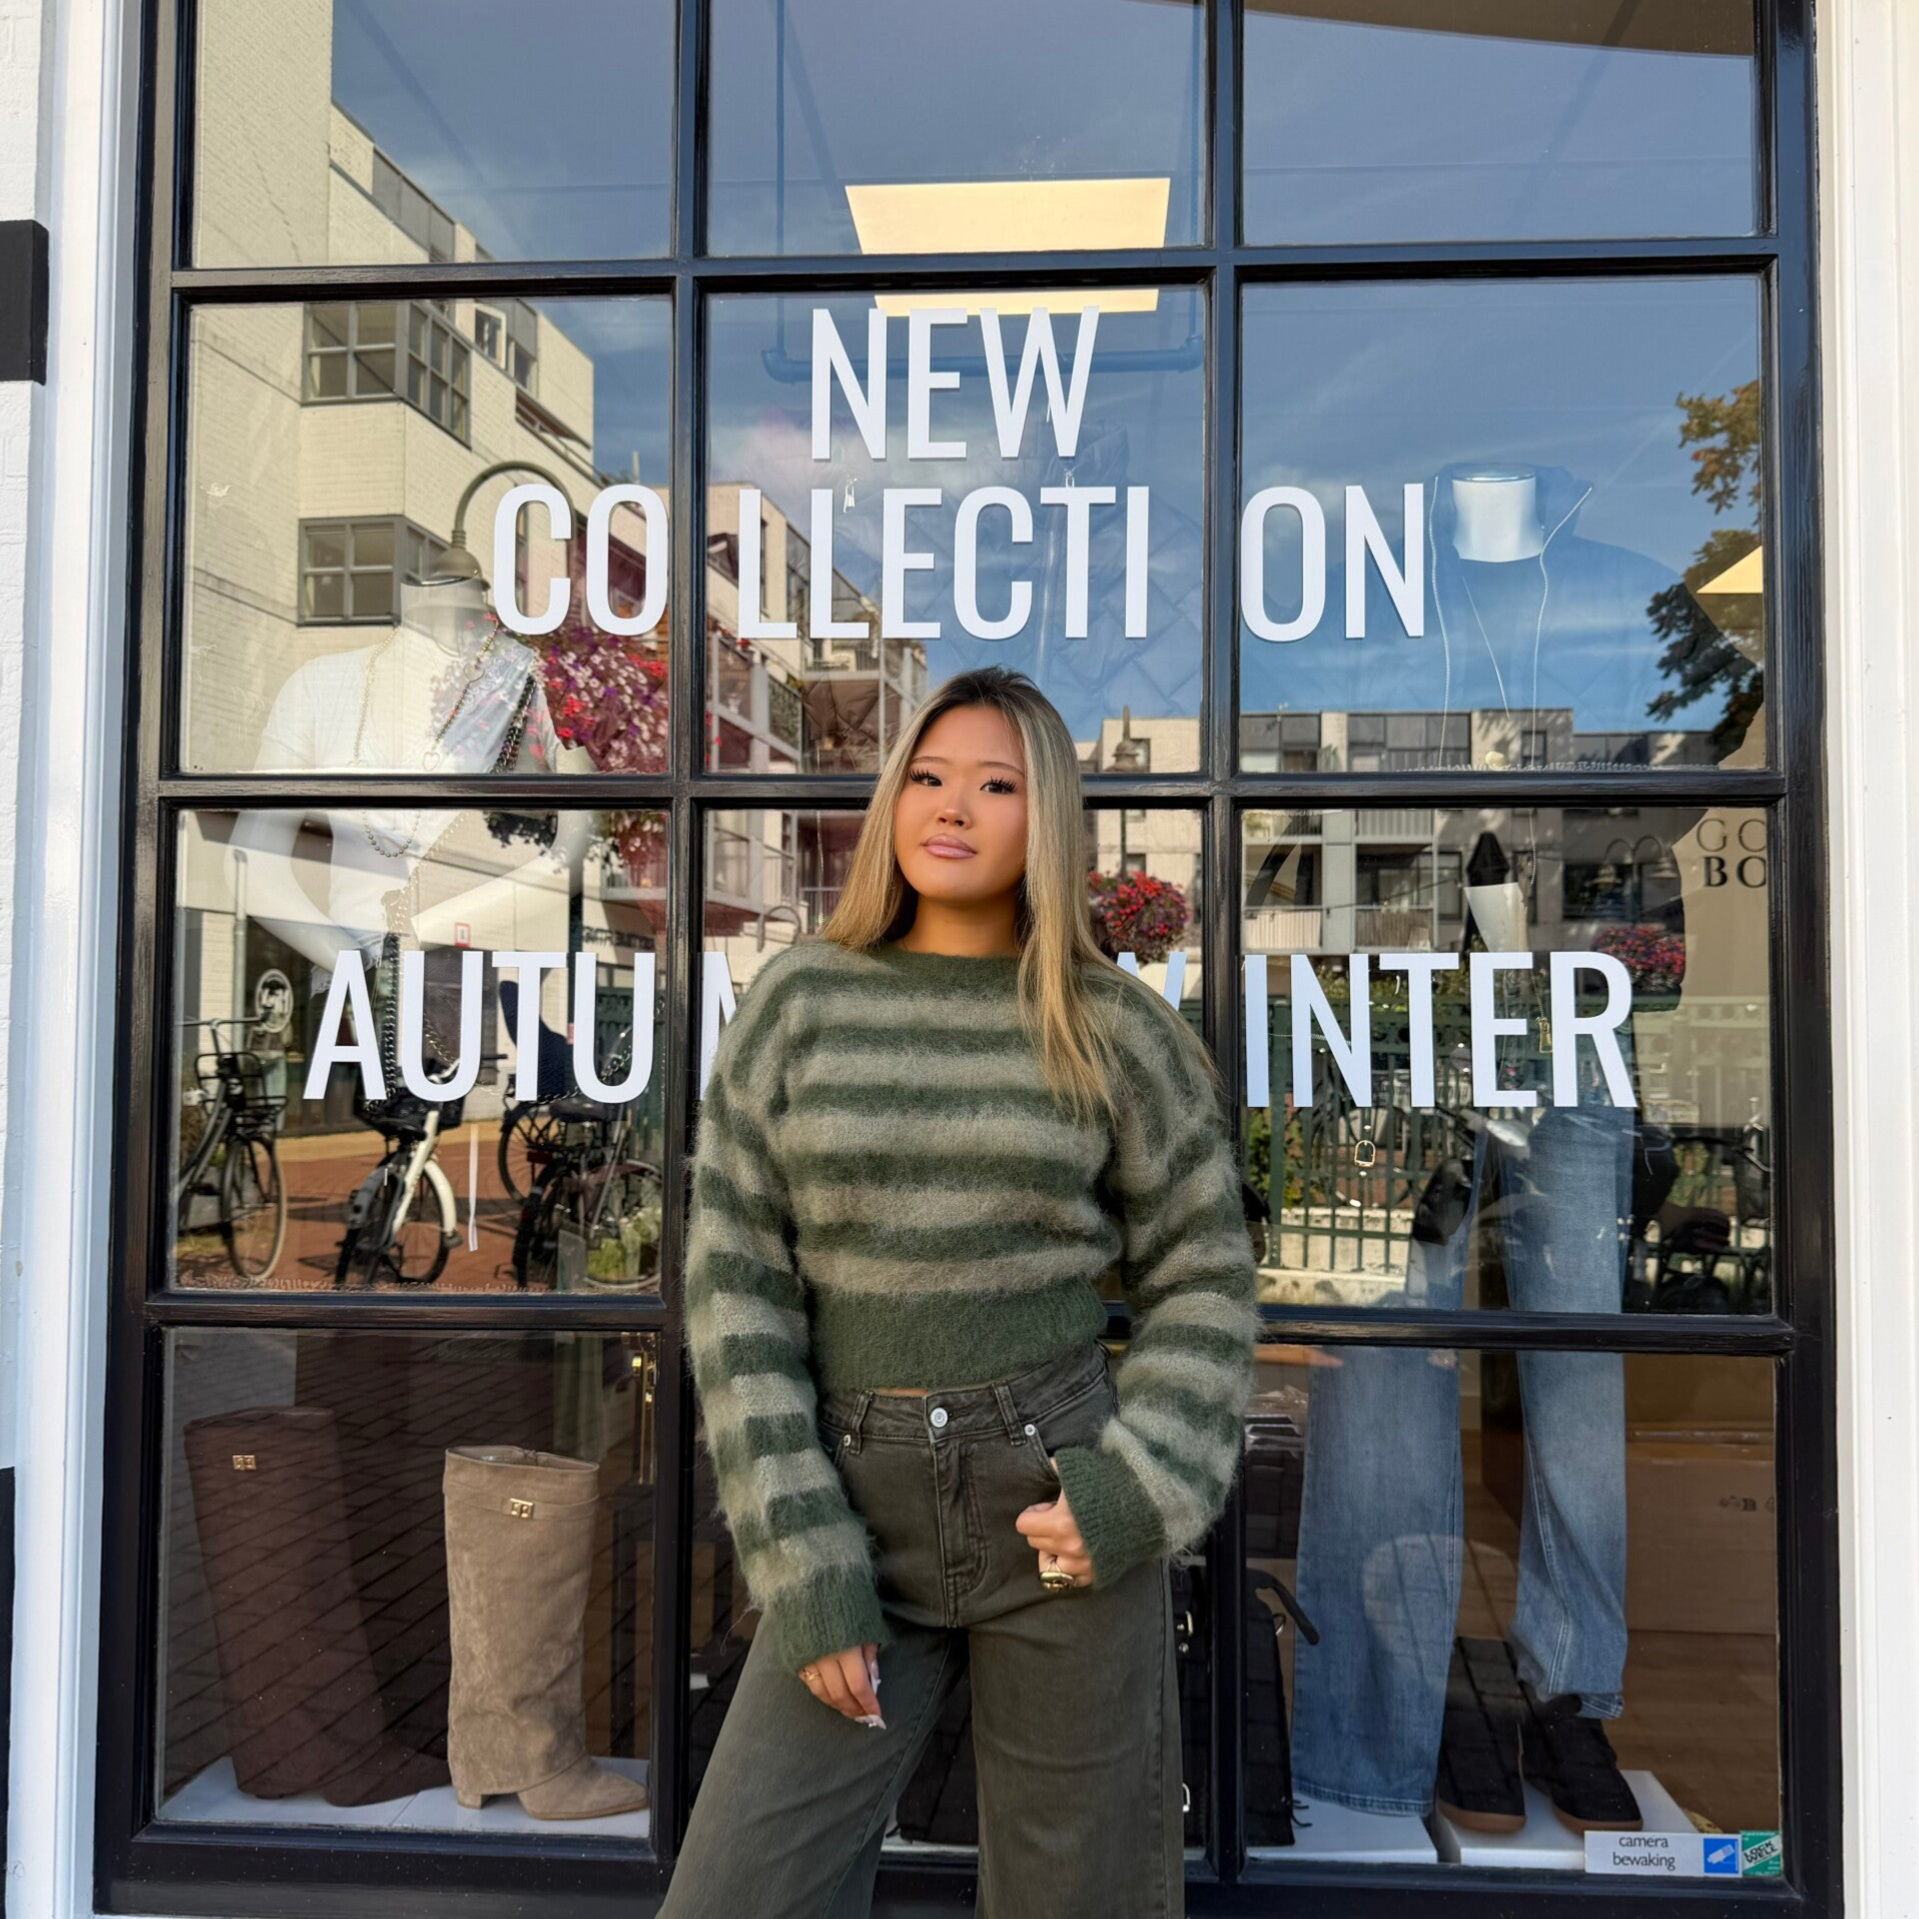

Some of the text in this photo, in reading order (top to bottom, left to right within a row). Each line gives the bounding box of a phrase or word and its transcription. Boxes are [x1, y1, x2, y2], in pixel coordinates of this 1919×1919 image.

[811, 304, 1102, 460] NEW
[493, 483, 1427, 642] COLLECTION
[1117, 948, 1638, 1110] INTER
[1612, 1851, 1675, 1872] bewaking
[1618, 1835, 1669, 1848] camera
